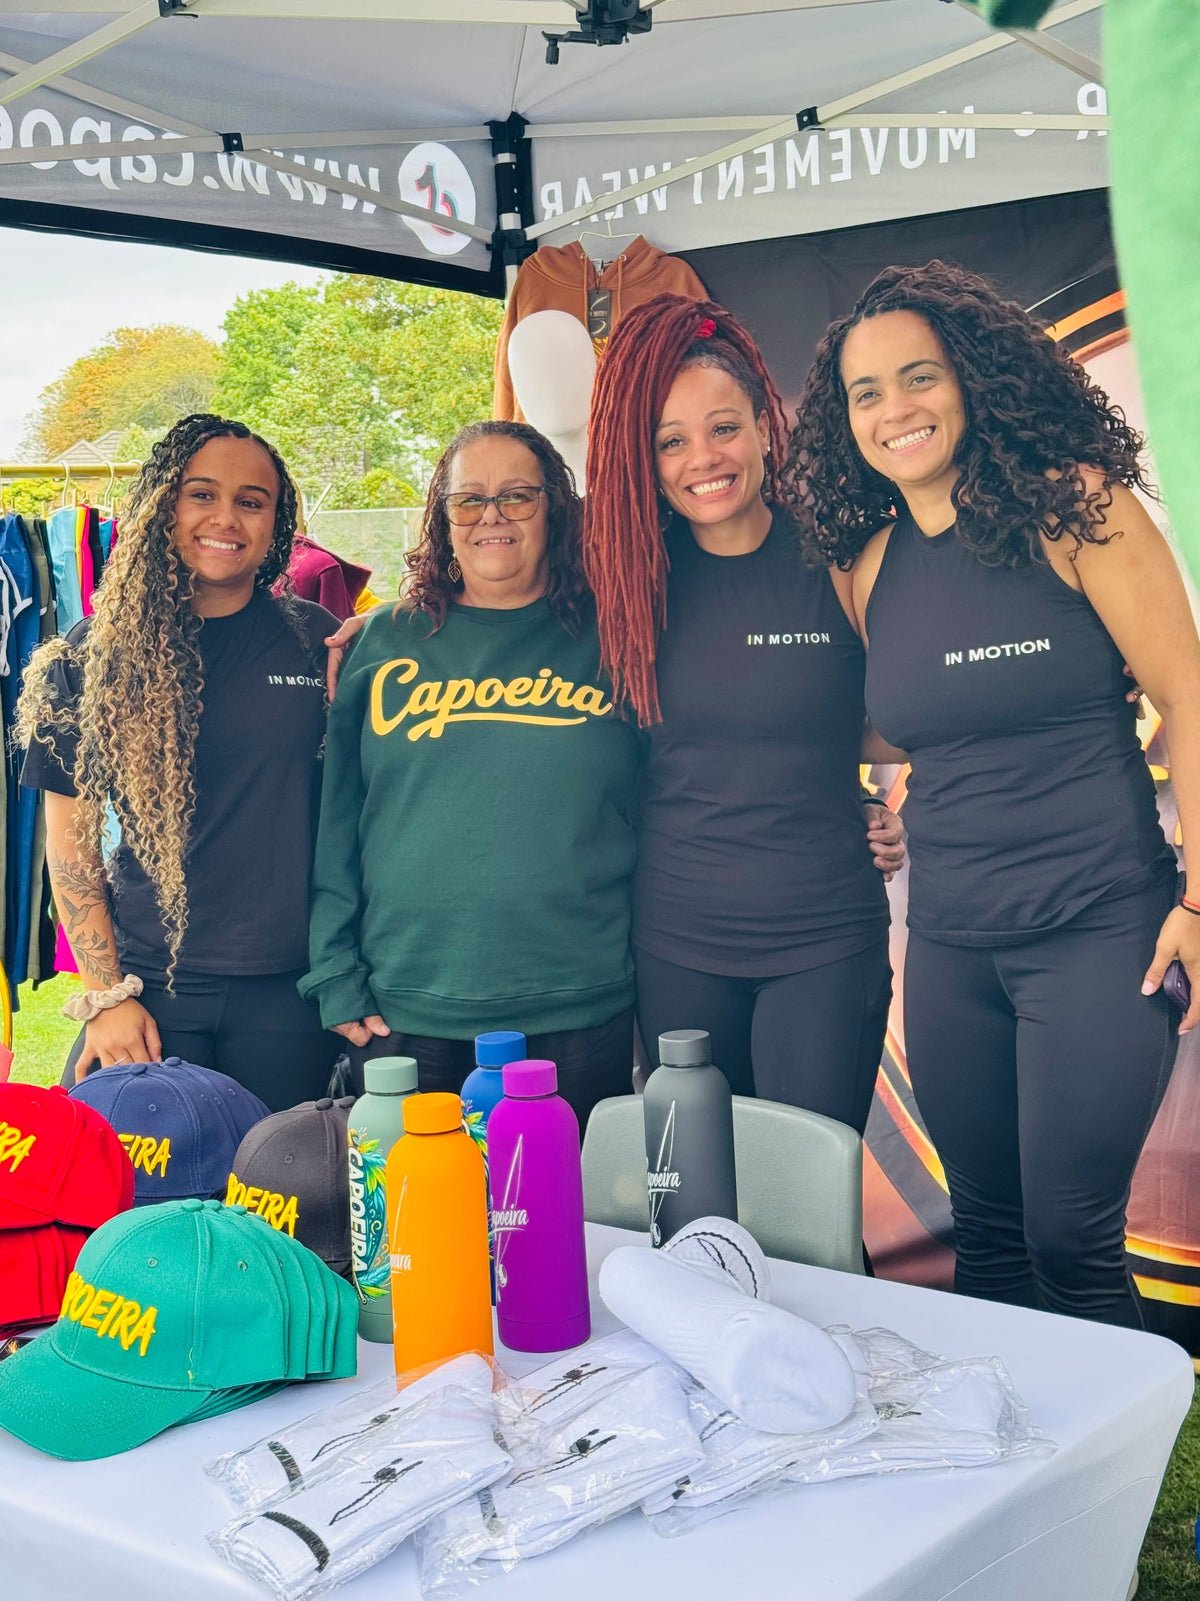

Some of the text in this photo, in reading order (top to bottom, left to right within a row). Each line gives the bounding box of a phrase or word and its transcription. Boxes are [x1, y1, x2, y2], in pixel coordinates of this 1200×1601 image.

[745, 632, 831, 646] IN MOTION
[945, 638, 1051, 666] IN MOTION
[268, 675, 324, 687] IN MOTIO
[371, 657, 614, 743] Capoeira
[348, 1146, 369, 1273] CAPOEIRA
